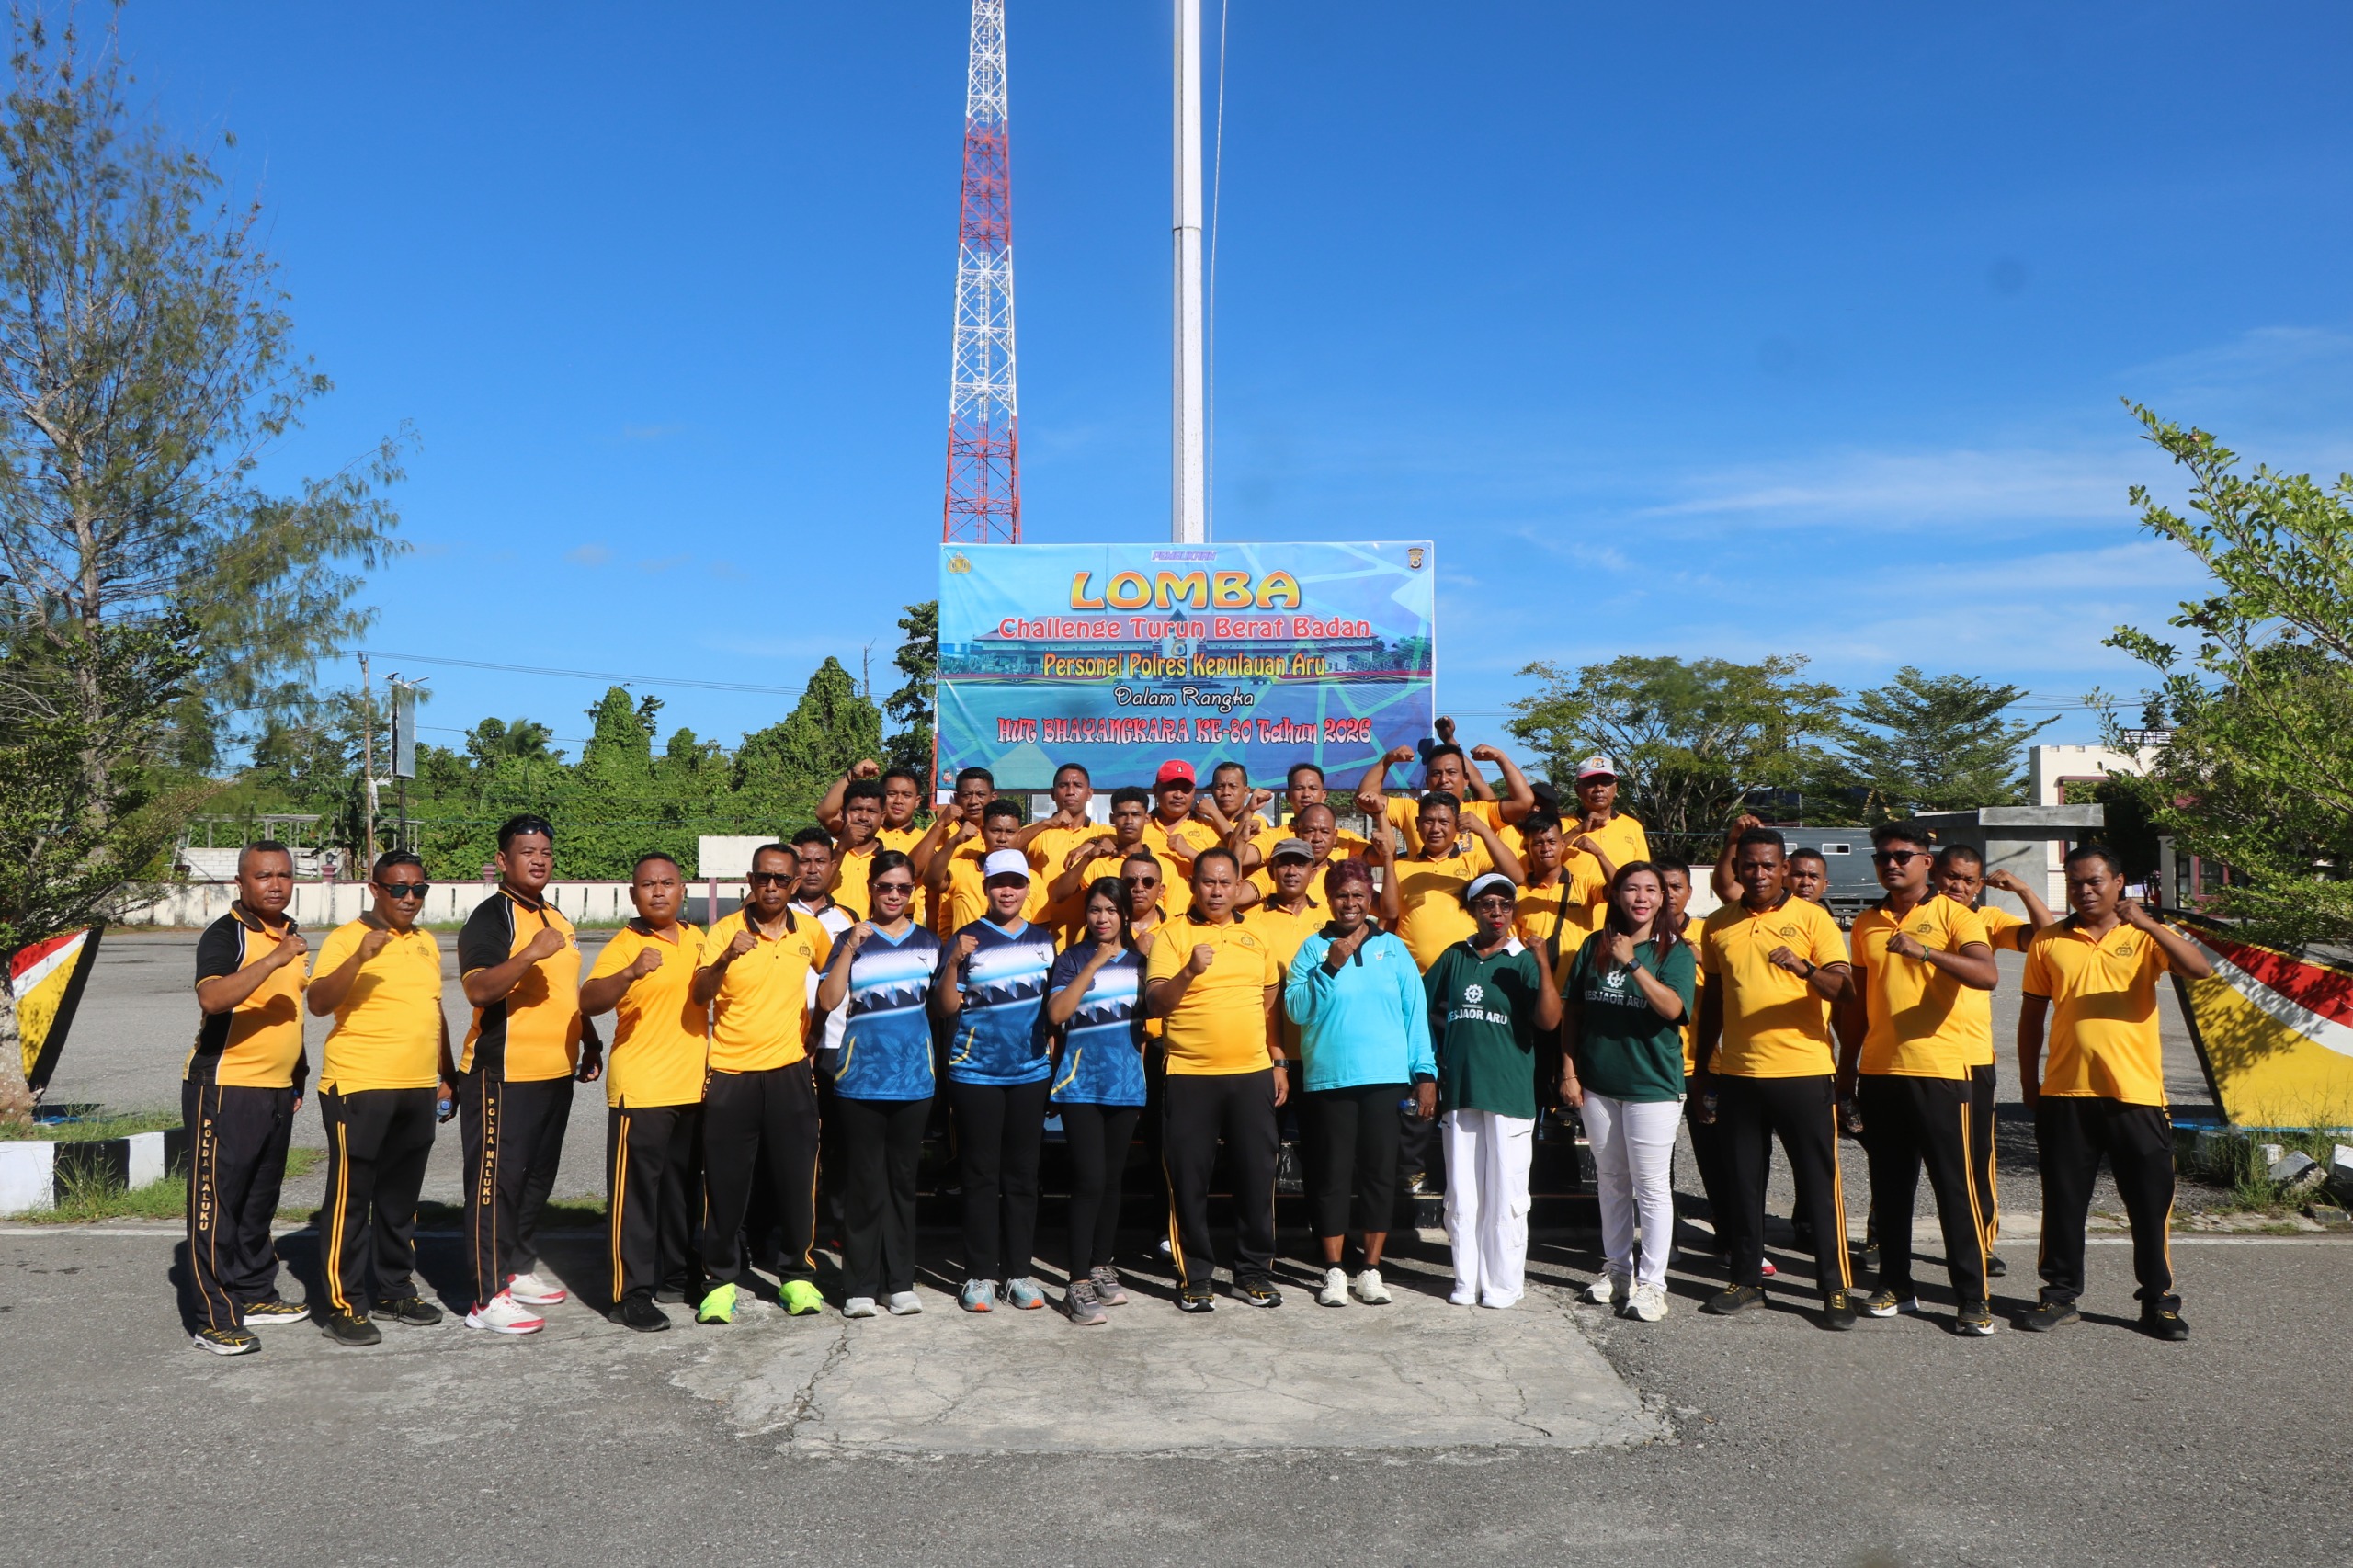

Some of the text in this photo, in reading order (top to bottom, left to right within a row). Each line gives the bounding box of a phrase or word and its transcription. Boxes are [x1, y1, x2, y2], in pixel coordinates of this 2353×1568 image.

[1070, 570, 1300, 609] LOMBA
[998, 617, 1370, 639] Challenge Turun Berat Badan
[1042, 652, 1123, 676] Personel
[1129, 652, 1186, 676] Polres
[1192, 652, 1287, 676] Kepulauan
[1291, 653, 1326, 676] Aru
[1113, 686, 1255, 713] Dalam Rangka
[997, 716, 1371, 744] HUT BHAYANGKARA KE-80 Tahun 2026
[1626, 995, 1647, 1009] ARU
[1485, 1012, 1507, 1025] ARU
[482, 1098, 495, 1205] POLDA MALUKU
[199, 1119, 212, 1231] POLDA MALUKU
